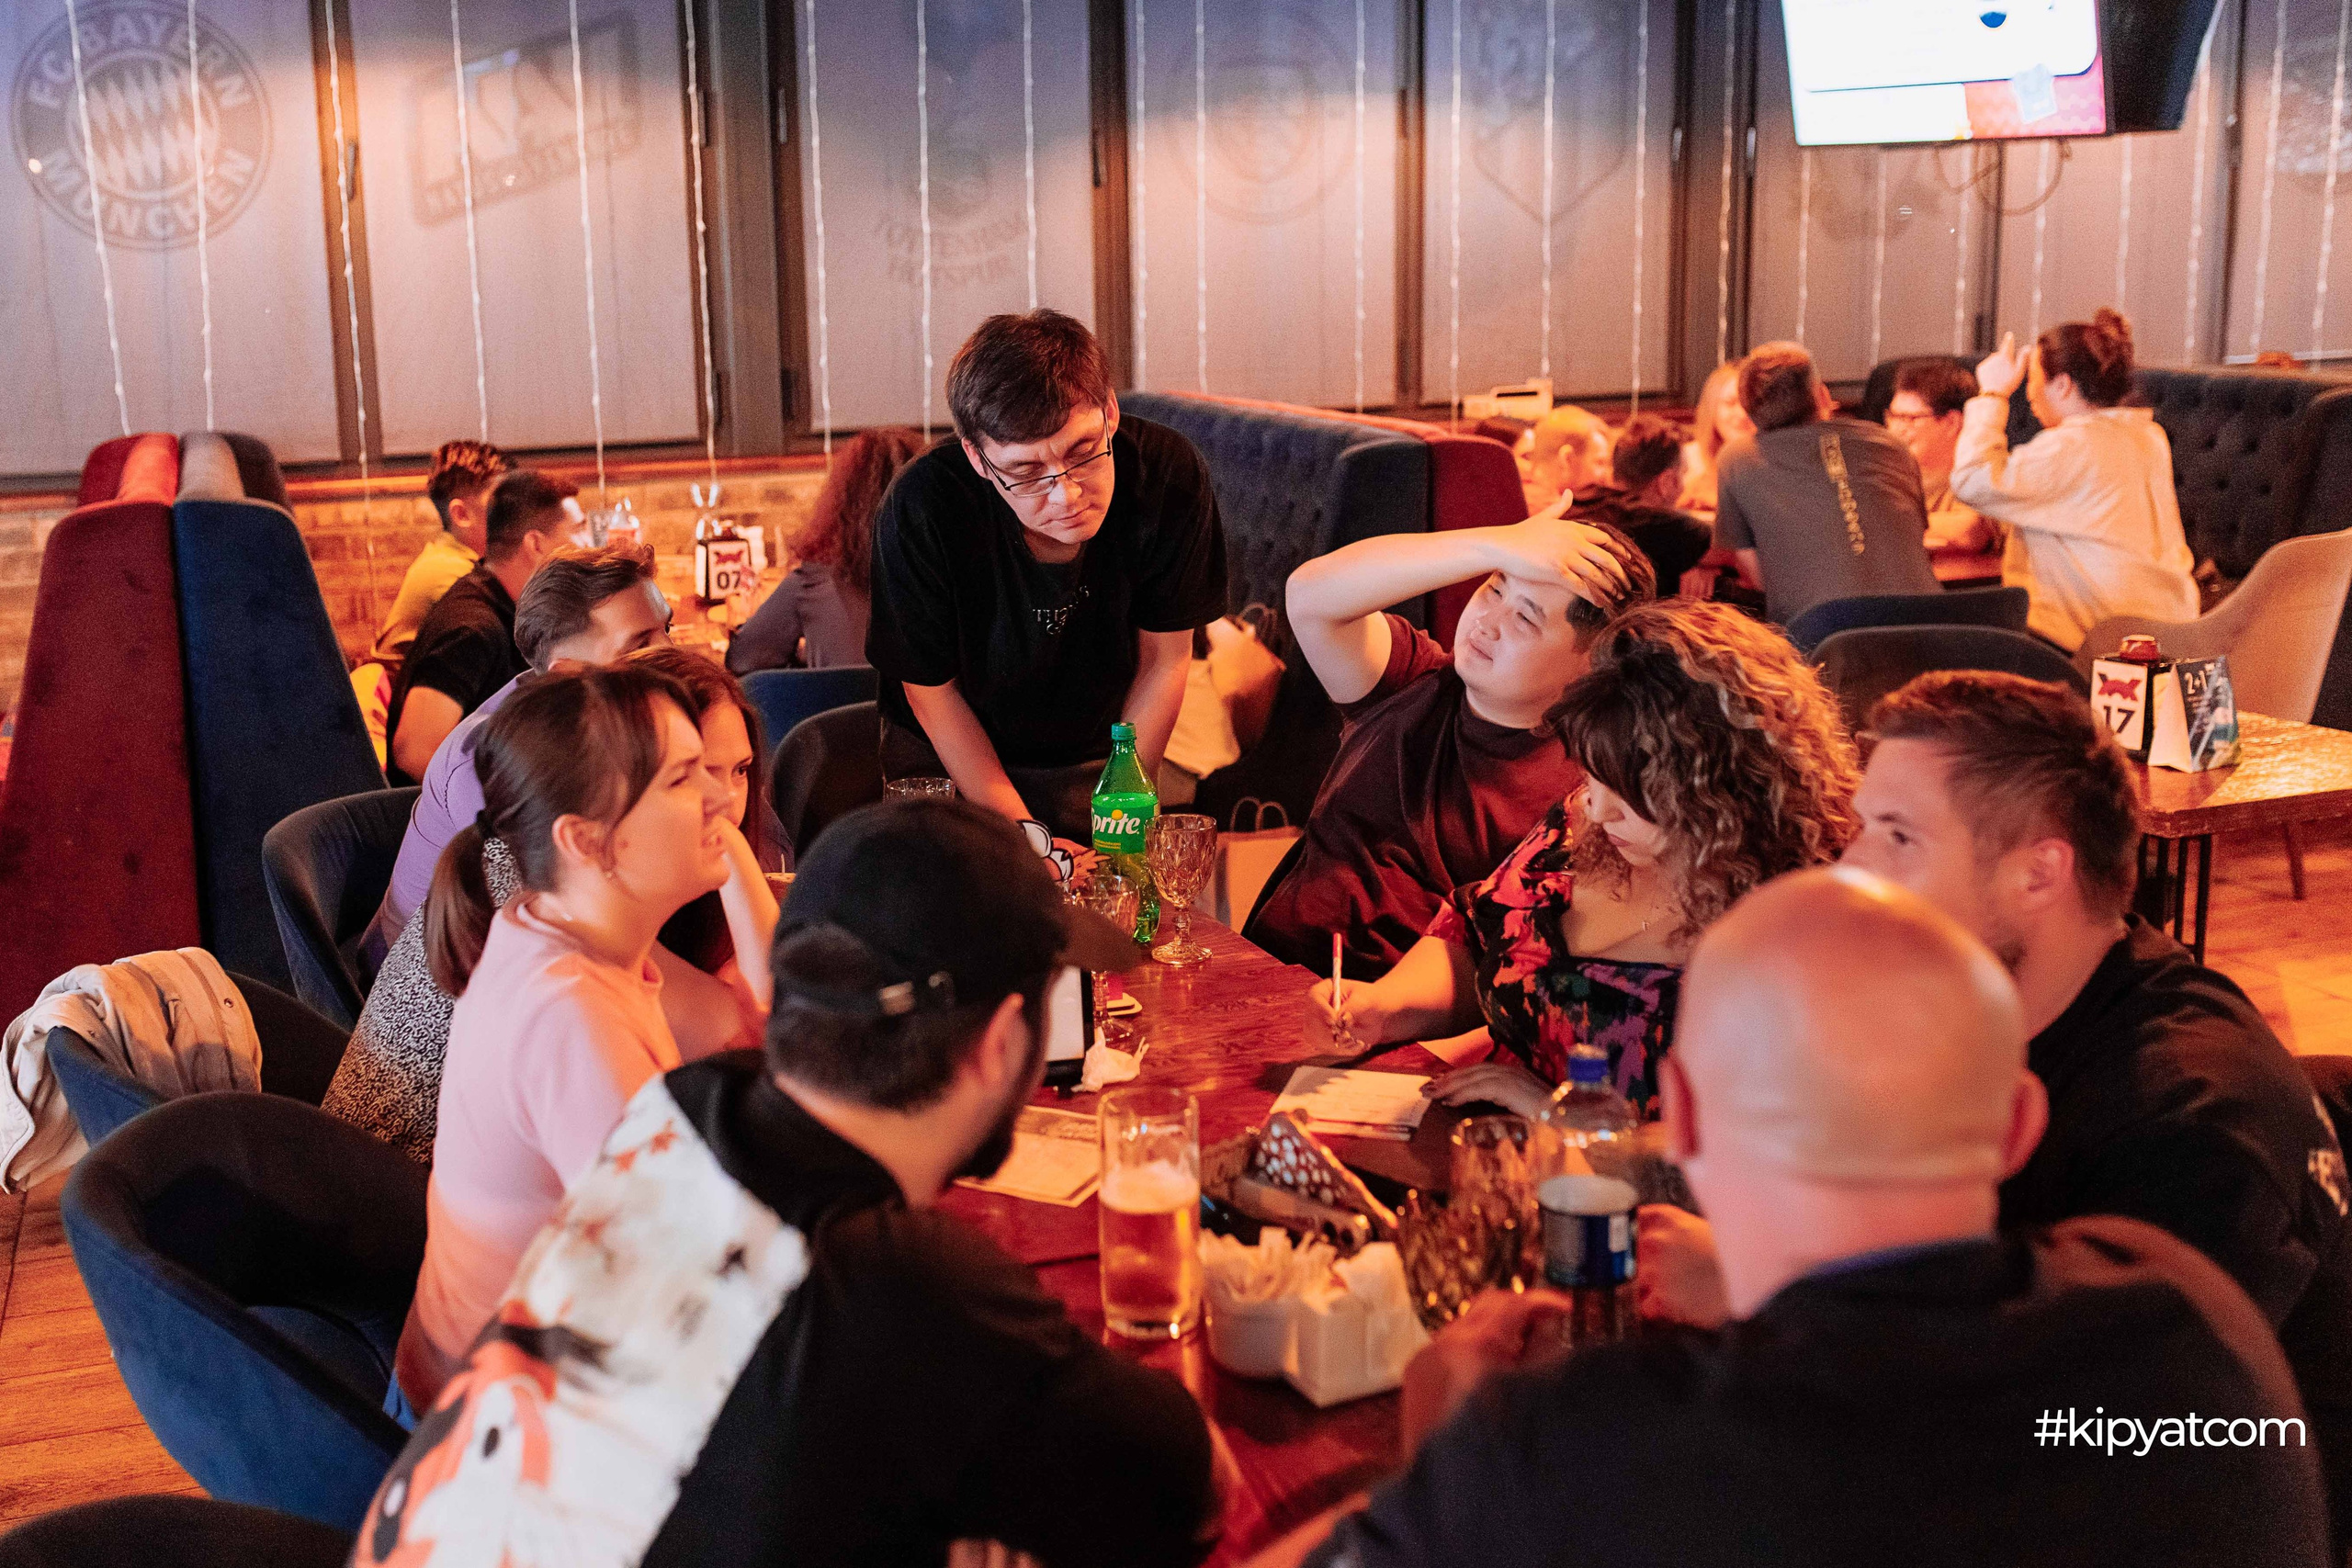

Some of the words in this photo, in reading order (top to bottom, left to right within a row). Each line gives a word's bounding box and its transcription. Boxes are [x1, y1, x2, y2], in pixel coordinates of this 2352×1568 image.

[28, 52, 74, 111] FC
[78, 13, 253, 109] BAYERN
[717, 570, 741, 590] 07
[2103, 705, 2136, 734] 17
[1091, 807, 1141, 835] prite
